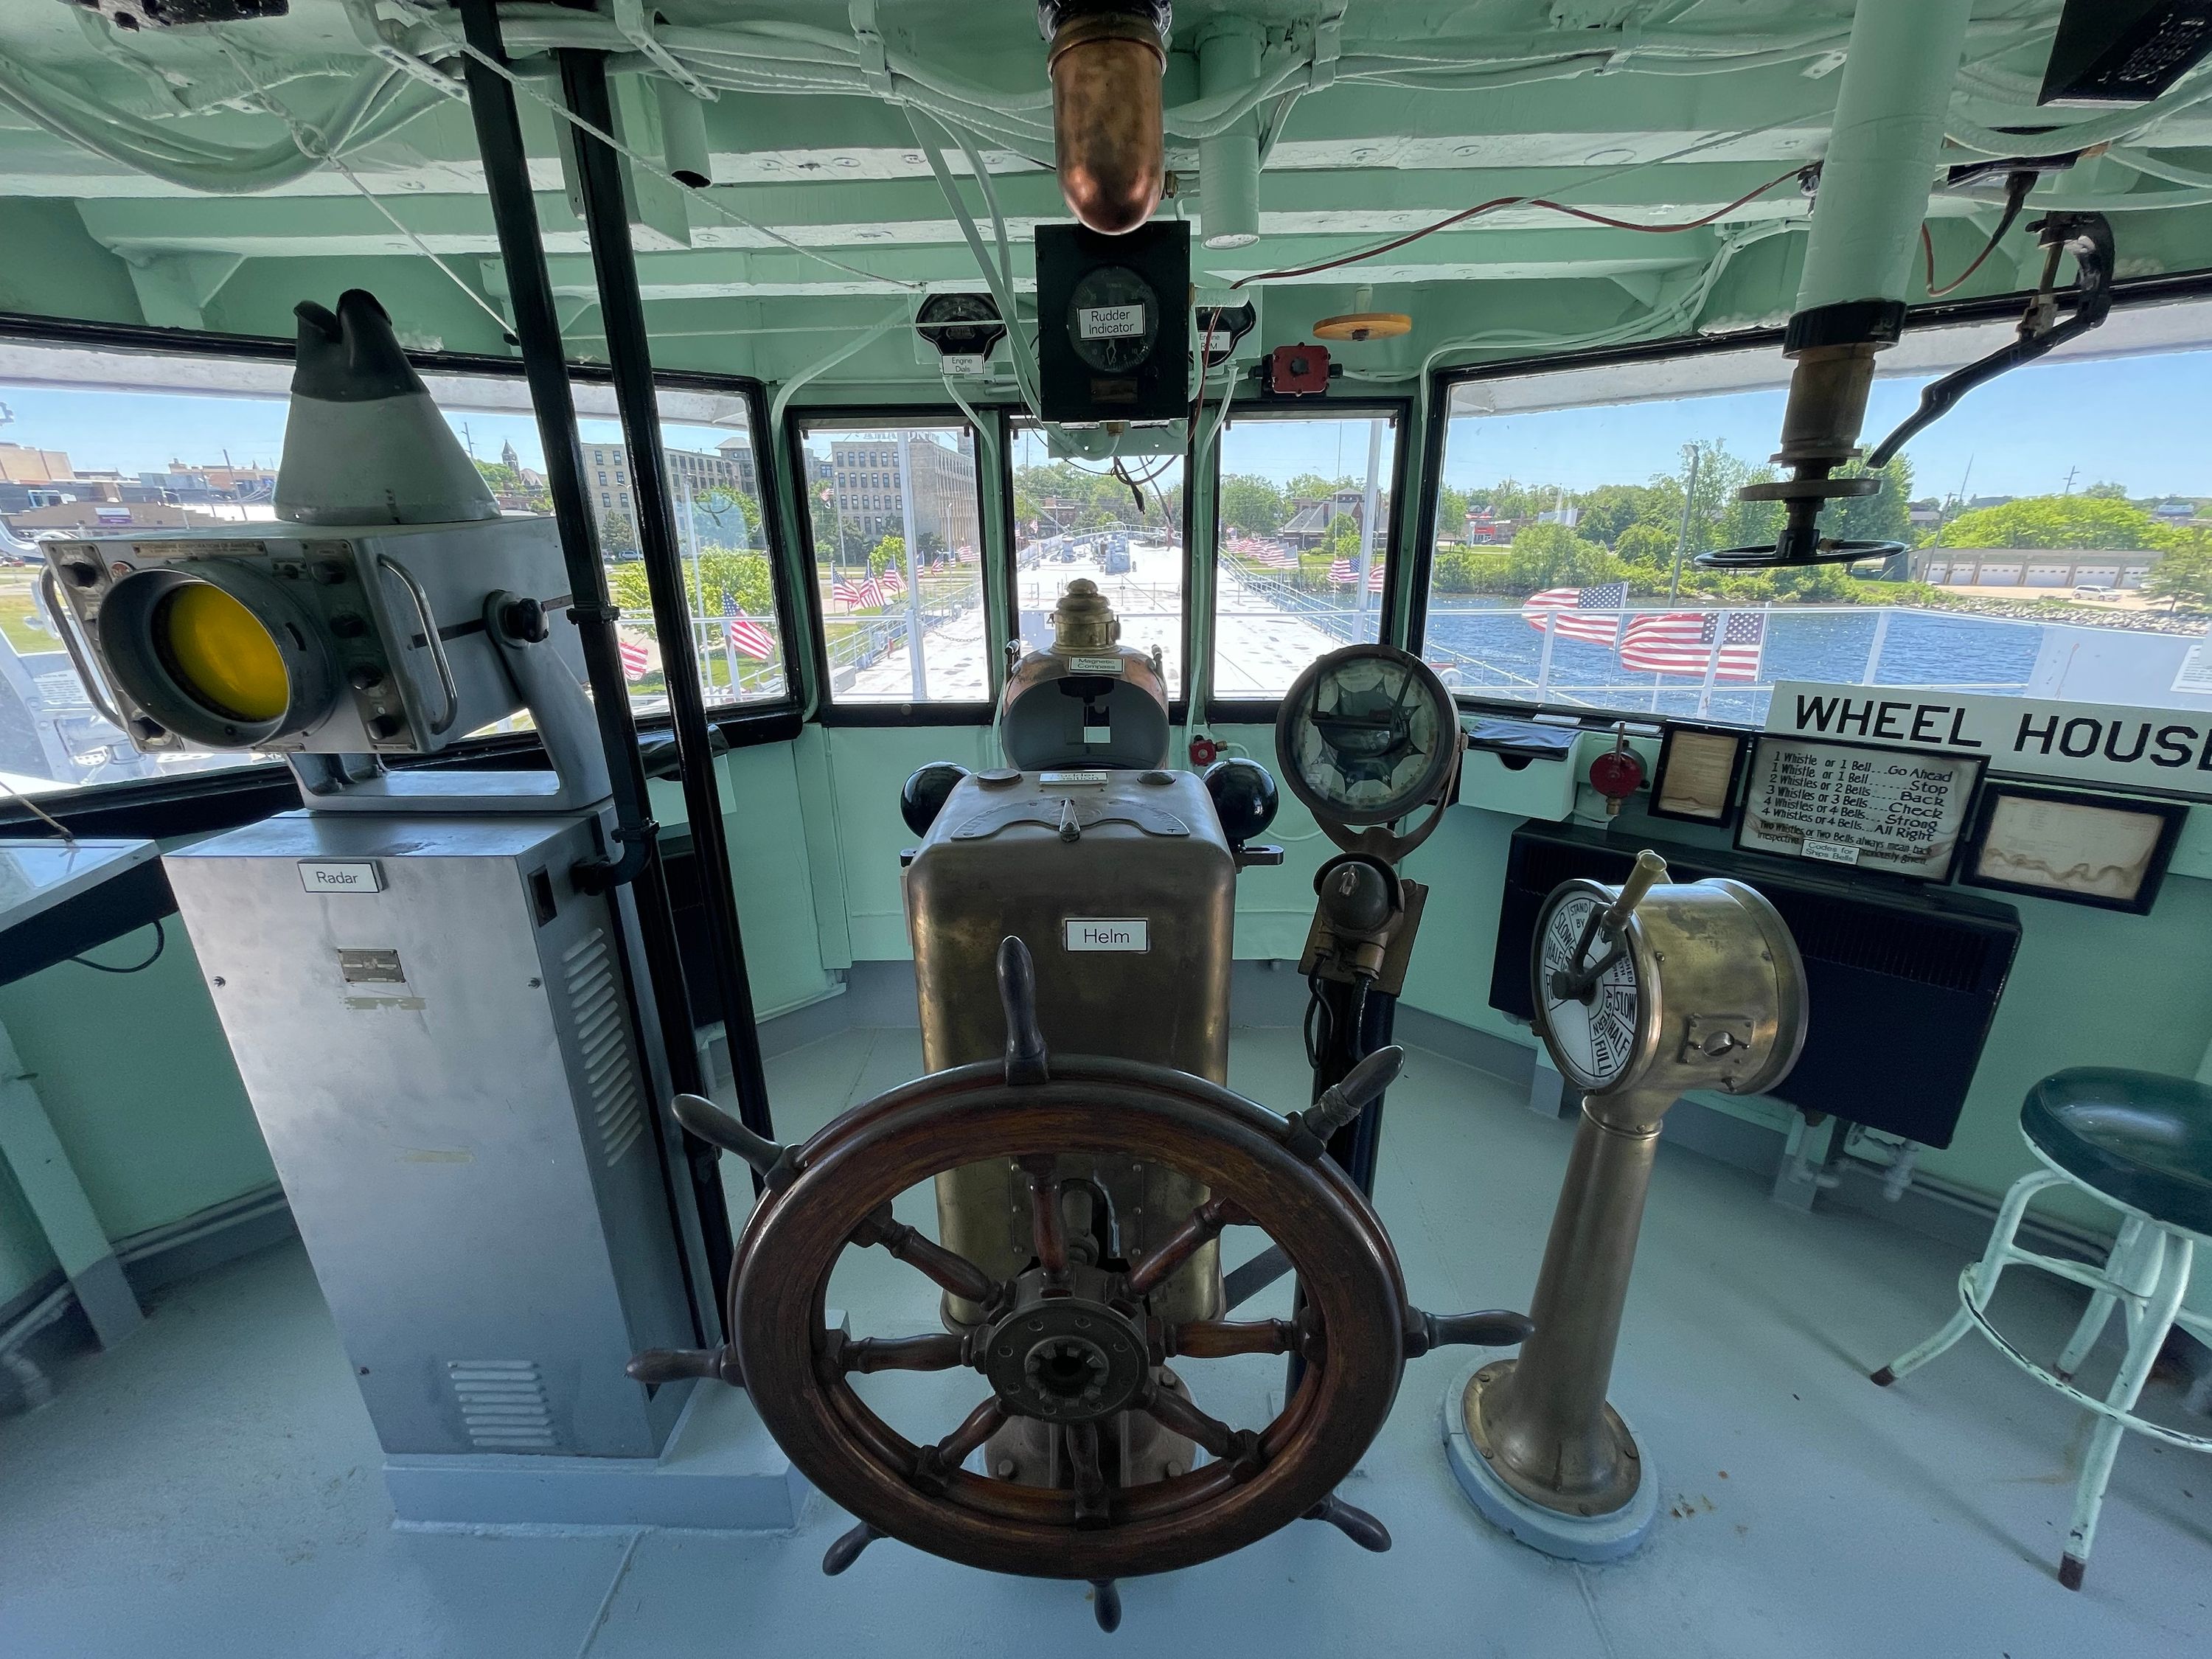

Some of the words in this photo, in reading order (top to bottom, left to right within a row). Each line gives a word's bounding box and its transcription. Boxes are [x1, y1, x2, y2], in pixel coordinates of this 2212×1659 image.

[1089, 323, 1134, 335] Indicator
[1091, 310, 1130, 322] Rudder
[951, 357, 973, 365] Engine
[1796, 695, 1982, 748] WHEEL
[1771, 762, 1778, 772] 1
[1781, 764, 1815, 778] Whistle
[1822, 771, 1834, 779] or
[1837, 771, 1844, 782] 1
[1910, 780, 1948, 796] Stop
[1774, 751, 1780, 762] 1
[1784, 753, 1818, 765] Whistle
[1840, 759, 1847, 769] 1
[1888, 765, 1907, 775] Go
[1910, 768, 1953, 782] Ahead
[1766, 785, 1775, 794] 3
[1778, 787, 1815, 801] Whistles
[1818, 794, 1829, 802] or
[1831, 795, 1840, 804] 3
[1888, 802, 1943, 819] Check
[1770, 774, 1777, 783] 2
[1780, 776, 1818, 789] Whistles
[1820, 782, 1832, 790] or
[1834, 783, 1843, 793] 2
[1900, 791, 1944, 807] Back
[1761, 807, 1770, 815] 4
[1773, 809, 1813, 822] Whistles
[1815, 816, 1826, 824] or
[1827, 817, 1835, 825] 4
[1874, 824, 1893, 835] All
[1896, 827, 1934, 842] Right
[1764, 796, 1771, 805] 4
[1775, 797, 1814, 812] Whistles
[1817, 804, 1828, 813] or
[1829, 805, 1837, 815] 4
[1885, 814, 1938, 834] Strong
[1759, 819, 1774, 830] Two
[1775, 823, 1804, 835] Whistles
[1806, 829, 1815, 837] or
[1817, 830, 1831, 838] Two
[1834, 832, 1854, 844] Bells
[1856, 836, 1884, 851] always
[1888, 842, 1910, 852] mean
[1808, 842, 1838, 852] Codes
[1842, 846, 1854, 855] for
[1806, 849, 1829, 858] Ships
[1832, 853, 1854, 862] Bells
[316, 871, 358, 884] Radar
[1570, 902, 1588, 916] STAND
[1576, 919, 1585, 928] BY
[1084, 928, 1130, 943] Helm
[1555, 912, 1573, 947] SLOW
[1548, 937, 1563, 965] HALF
[1593, 989, 1613, 1035] ASTERN
[1615, 991, 1636, 1024] SLOW
[1607, 1020, 1630, 1057] HALF
[1595, 1040, 1613, 1074] FULL
